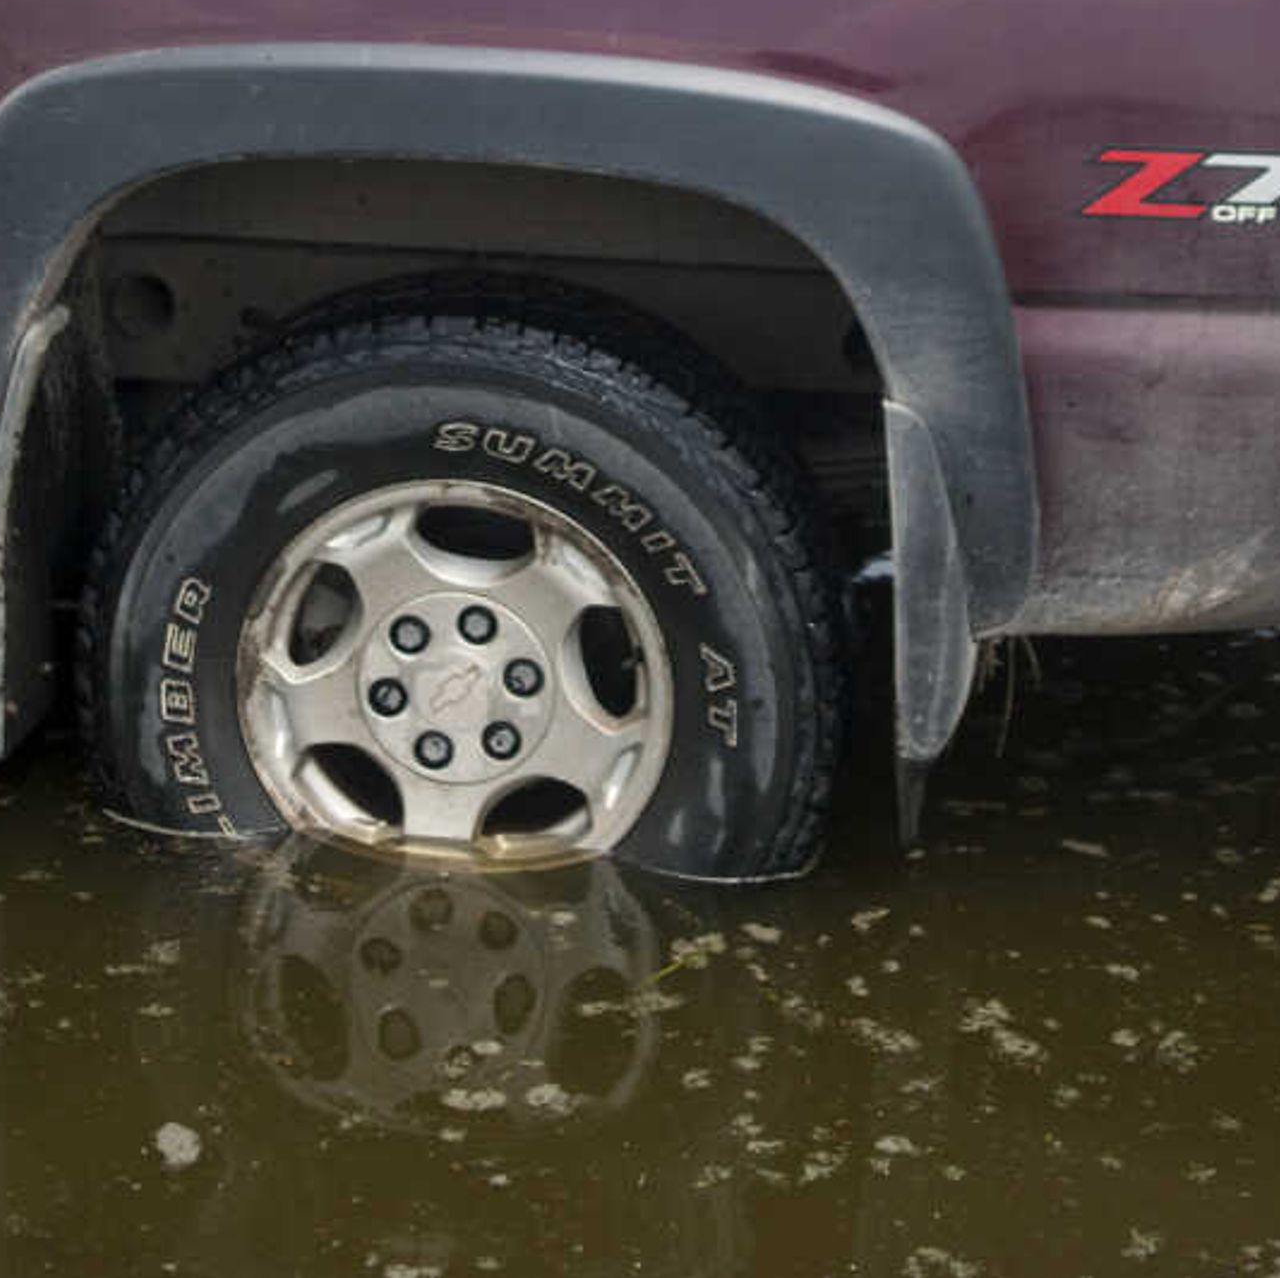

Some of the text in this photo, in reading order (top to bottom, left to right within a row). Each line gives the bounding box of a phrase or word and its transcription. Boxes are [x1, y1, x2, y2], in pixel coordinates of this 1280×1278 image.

[1211, 204, 1277, 223] OFF
[433, 422, 738, 748] SUMMIT AT
